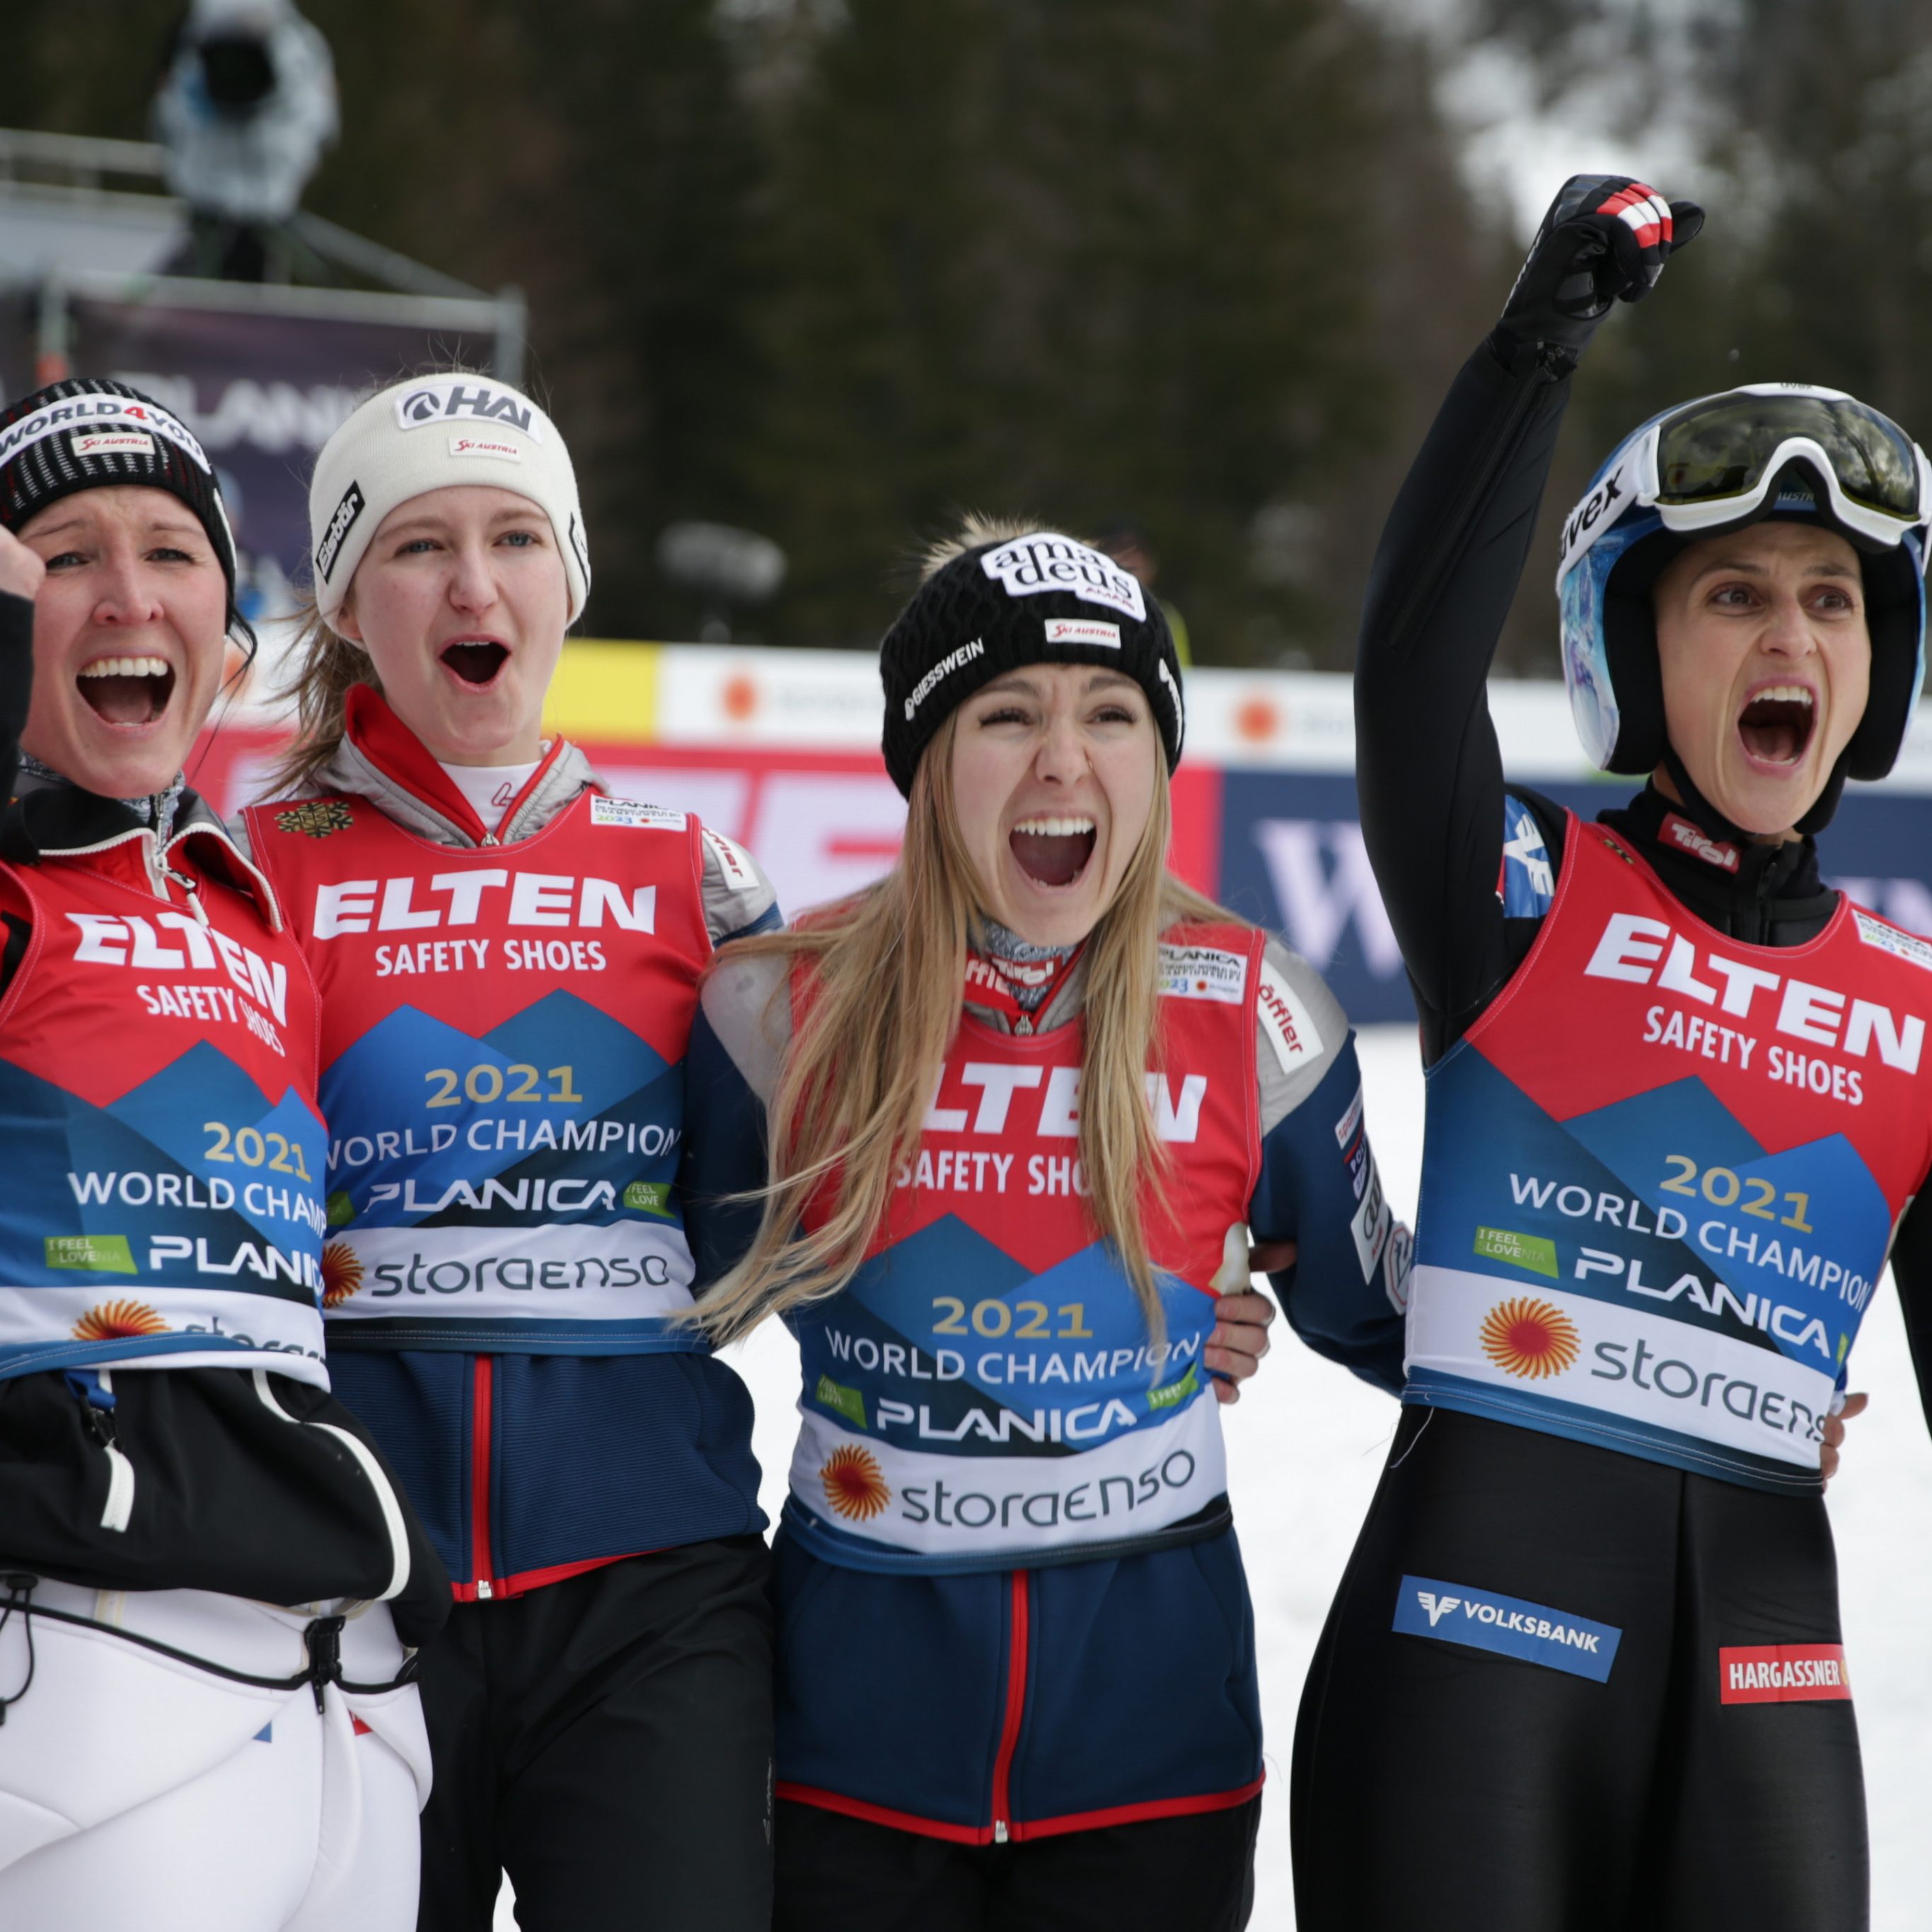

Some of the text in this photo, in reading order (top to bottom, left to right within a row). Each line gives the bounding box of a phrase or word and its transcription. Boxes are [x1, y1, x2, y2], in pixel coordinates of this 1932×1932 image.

[444, 386, 532, 432] HAI
[318, 492, 359, 569] Eisbär
[1014, 549, 1132, 599] deus
[912, 638, 985, 707] GIESSWEIN
[1671, 822, 1737, 867] Tirol
[313, 868, 656, 942] ELTEN
[64, 911, 287, 1028] ELTEN
[375, 939, 607, 978] SAFETY SHOES
[991, 957, 1055, 986] Tirol
[136, 984, 238, 1023] SAFETY
[1259, 983, 1303, 1053] öffler
[1583, 911, 1926, 1075] ELTEN
[1643, 1005, 1864, 1106] SAFETY SHOES
[424, 1063, 584, 1109] 2021
[920, 1061, 1208, 1144] LTEN
[203, 1121, 313, 1184] 2021
[66, 1171, 236, 1210] WORLD
[363, 1178, 618, 1213] PLANICA
[1659, 1154, 1814, 1235] 2021
[58, 1237, 94, 1251] FEEL
[1488, 1230, 1520, 1246] FEEL
[1509, 1173, 1872, 1312] WORLD CHAMPION
[371, 1253, 671, 1297] storaenso
[931, 1296, 1094, 1339] 2021
[1573, 1245, 1832, 1360] PLANICA
[824, 1326, 1201, 1384] WORLD CHAMPION
[1590, 1338, 1827, 1444] storaens
[876, 1396, 1138, 1443] PLANICA
[901, 1449, 1196, 1528] storaenso
[1463, 1600, 1600, 1654] VOLKSBANK
[1729, 1659, 1840, 1690] HARGASSNER
